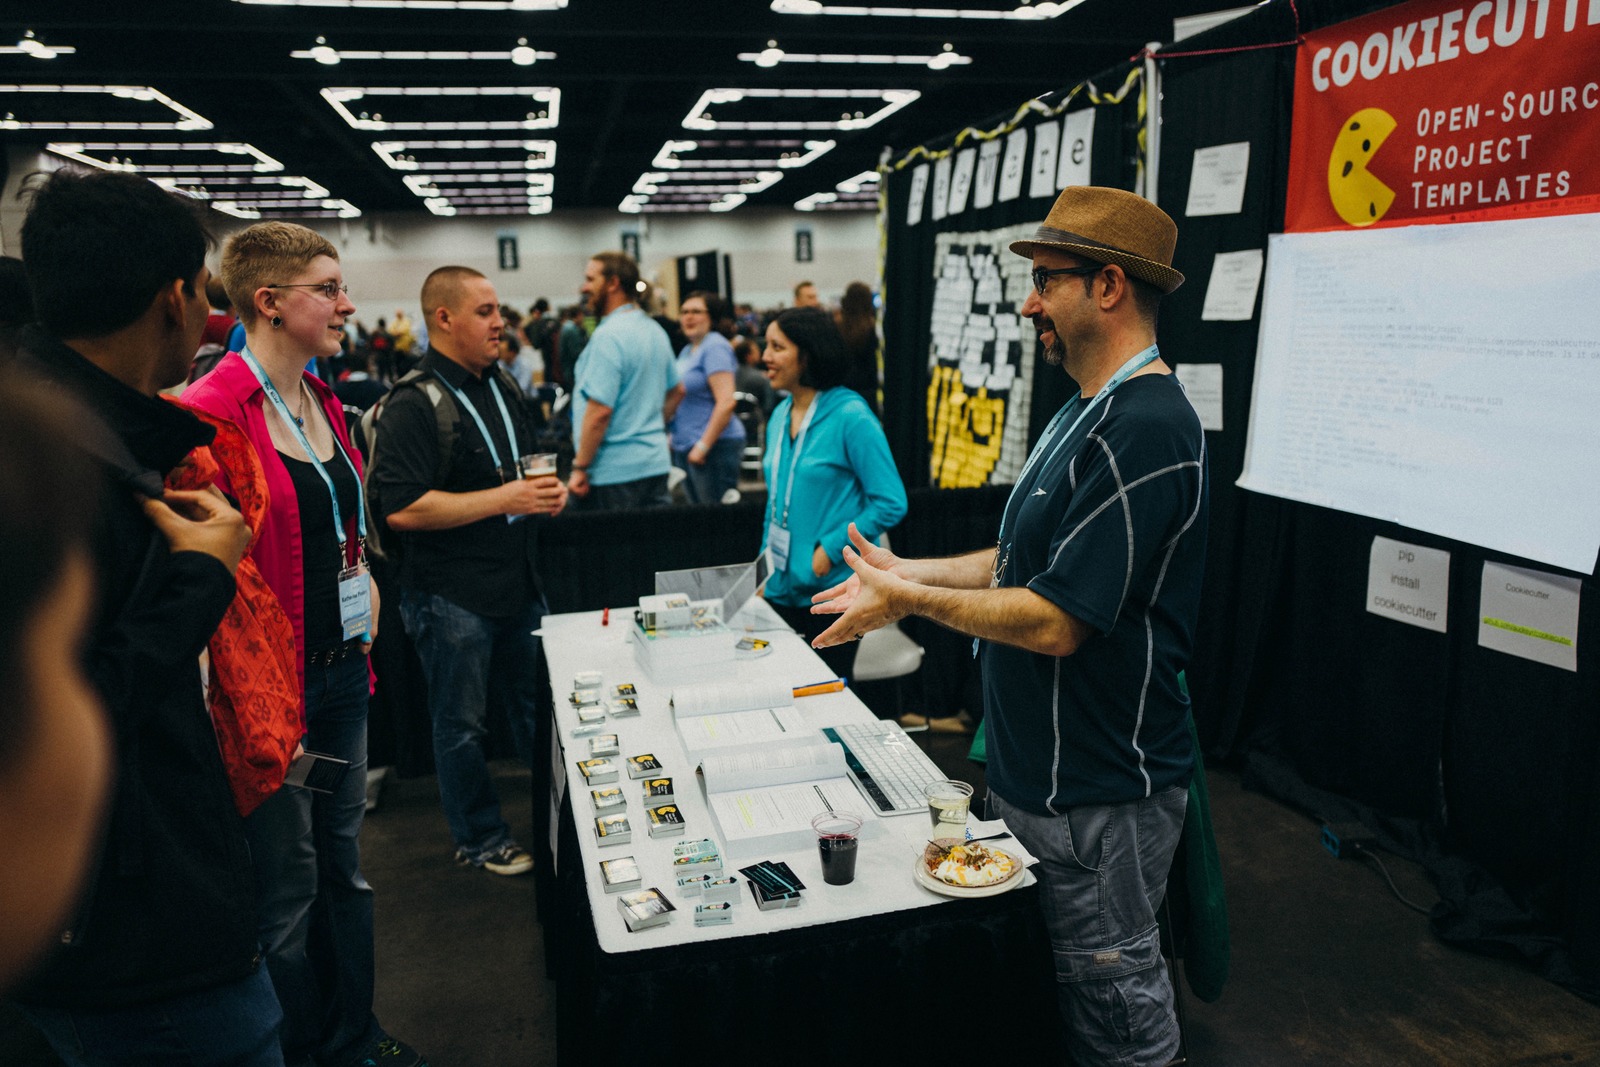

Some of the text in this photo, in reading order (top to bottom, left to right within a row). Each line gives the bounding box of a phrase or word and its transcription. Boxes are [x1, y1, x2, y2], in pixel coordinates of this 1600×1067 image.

[1413, 135, 1532, 173] PROJECT
[1412, 171, 1571, 209] TEMPLATES
[1398, 550, 1415, 563] pip
[1390, 573, 1420, 590] install
[1505, 582, 1550, 600] Cookiecutter
[1373, 594, 1437, 620] cookiecutter
